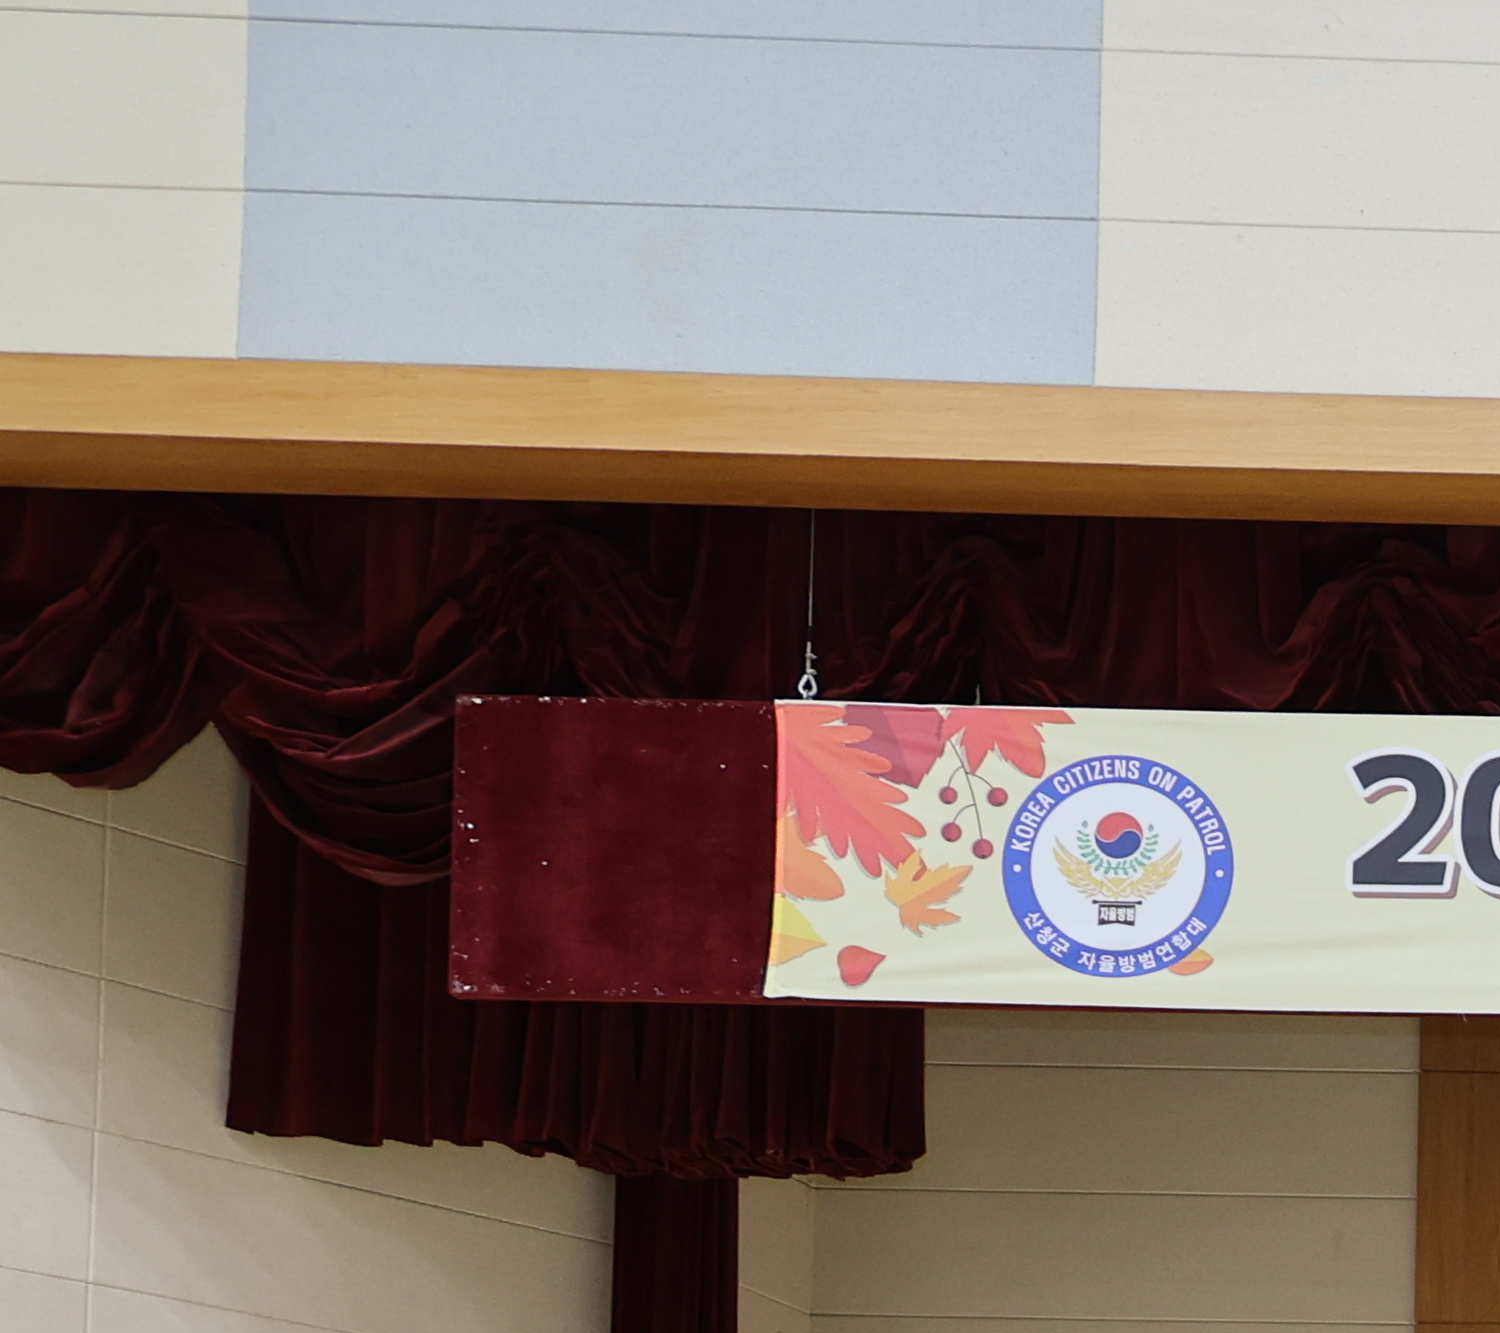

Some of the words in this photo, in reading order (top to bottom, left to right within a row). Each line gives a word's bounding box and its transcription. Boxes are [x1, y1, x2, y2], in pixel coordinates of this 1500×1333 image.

[1011, 791, 1055, 852] KOREA
[1053, 759, 1141, 794] CITIZENS
[1148, 766, 1178, 791] ON
[1176, 785, 1226, 855] PATROL
[1024, 911, 1070, 958] 산청군
[1077, 916, 1207, 973] 자율방범연합대
